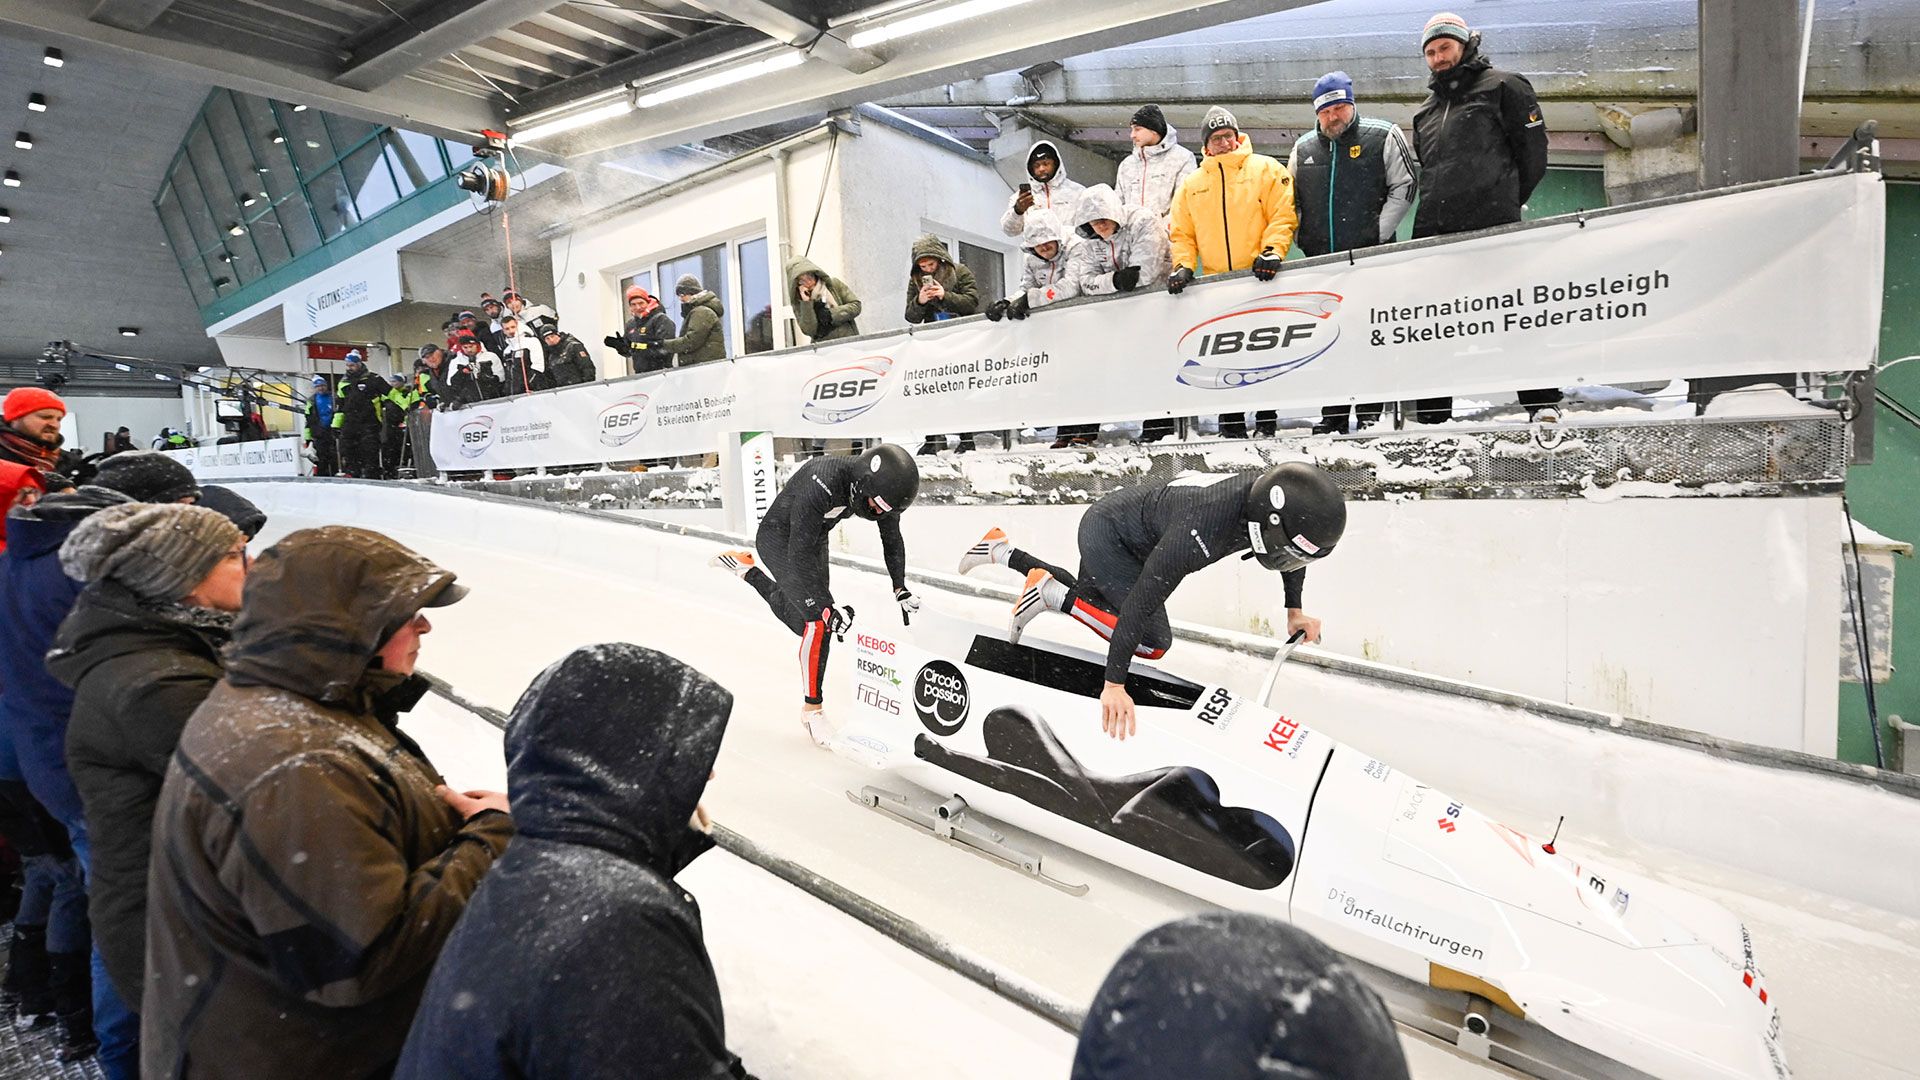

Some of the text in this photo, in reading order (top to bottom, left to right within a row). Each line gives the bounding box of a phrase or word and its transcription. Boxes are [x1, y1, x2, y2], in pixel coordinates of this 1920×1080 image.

[1369, 269, 1670, 324] International Bobsleigh
[1369, 301, 1648, 347] & Skeleton Federation
[1197, 322, 1317, 357] IBSF
[904, 351, 1050, 381] International Bobsleigh
[812, 378, 878, 400] IBSF
[903, 371, 1038, 397] & Skeleton Federation
[656, 399, 703, 415] International
[603, 411, 640, 429] IBSF
[663, 414, 695, 426] Skeleton
[463, 431, 489, 443] IBSF
[754, 469, 768, 526] ELTINS
[857, 633, 896, 655] KEBOS
[857, 658, 897, 680] RESPOFIT
[923, 668, 962, 691] Circolo
[857, 683, 901, 716] fidas
[923, 683, 966, 706] passion
[1197, 687, 1232, 725] RESP
[1292, 730, 1309, 753] AUSTRIA
[1328, 888, 1356, 906] Die
[1343, 904, 1484, 960] Unfallchirurgen
